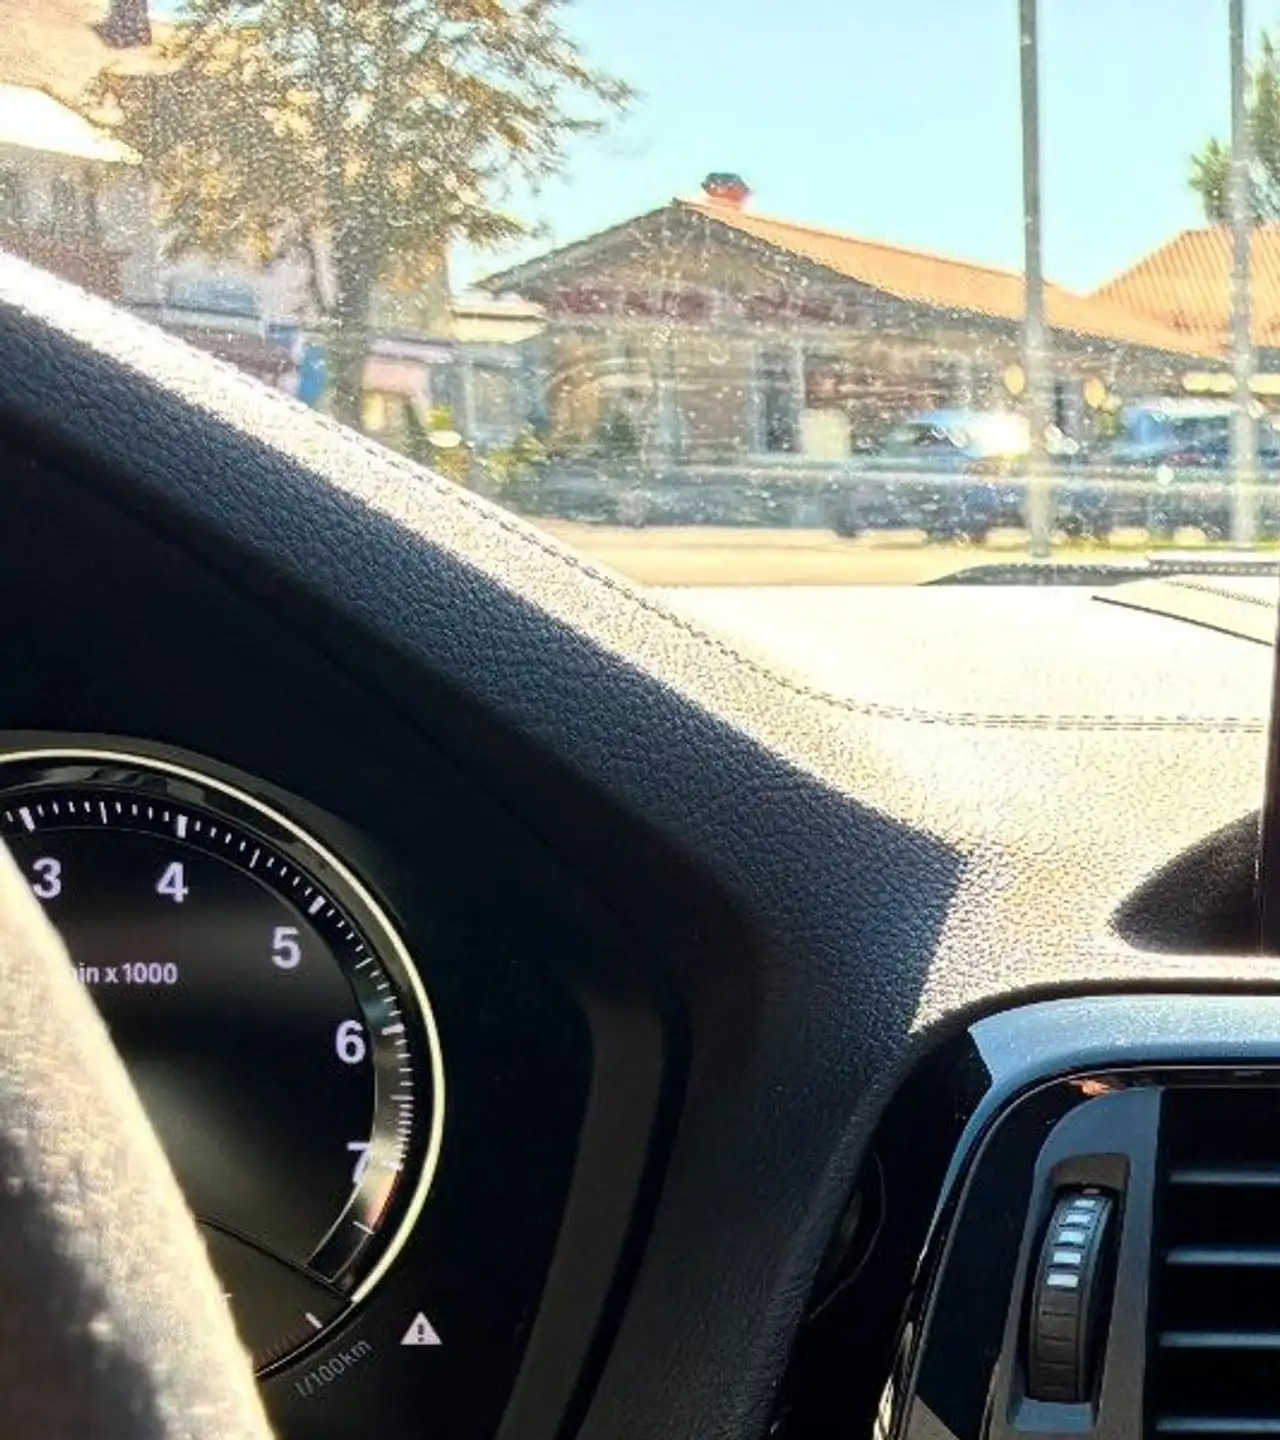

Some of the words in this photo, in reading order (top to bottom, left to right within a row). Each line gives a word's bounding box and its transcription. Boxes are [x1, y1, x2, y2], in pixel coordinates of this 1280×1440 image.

[32, 857, 62, 899] 3
[157, 862, 189, 903] 4
[271, 927, 301, 970] 5
[104, 966, 120, 984] x
[122, 961, 179, 985] 1000
[335, 1019, 366, 1065] 6
